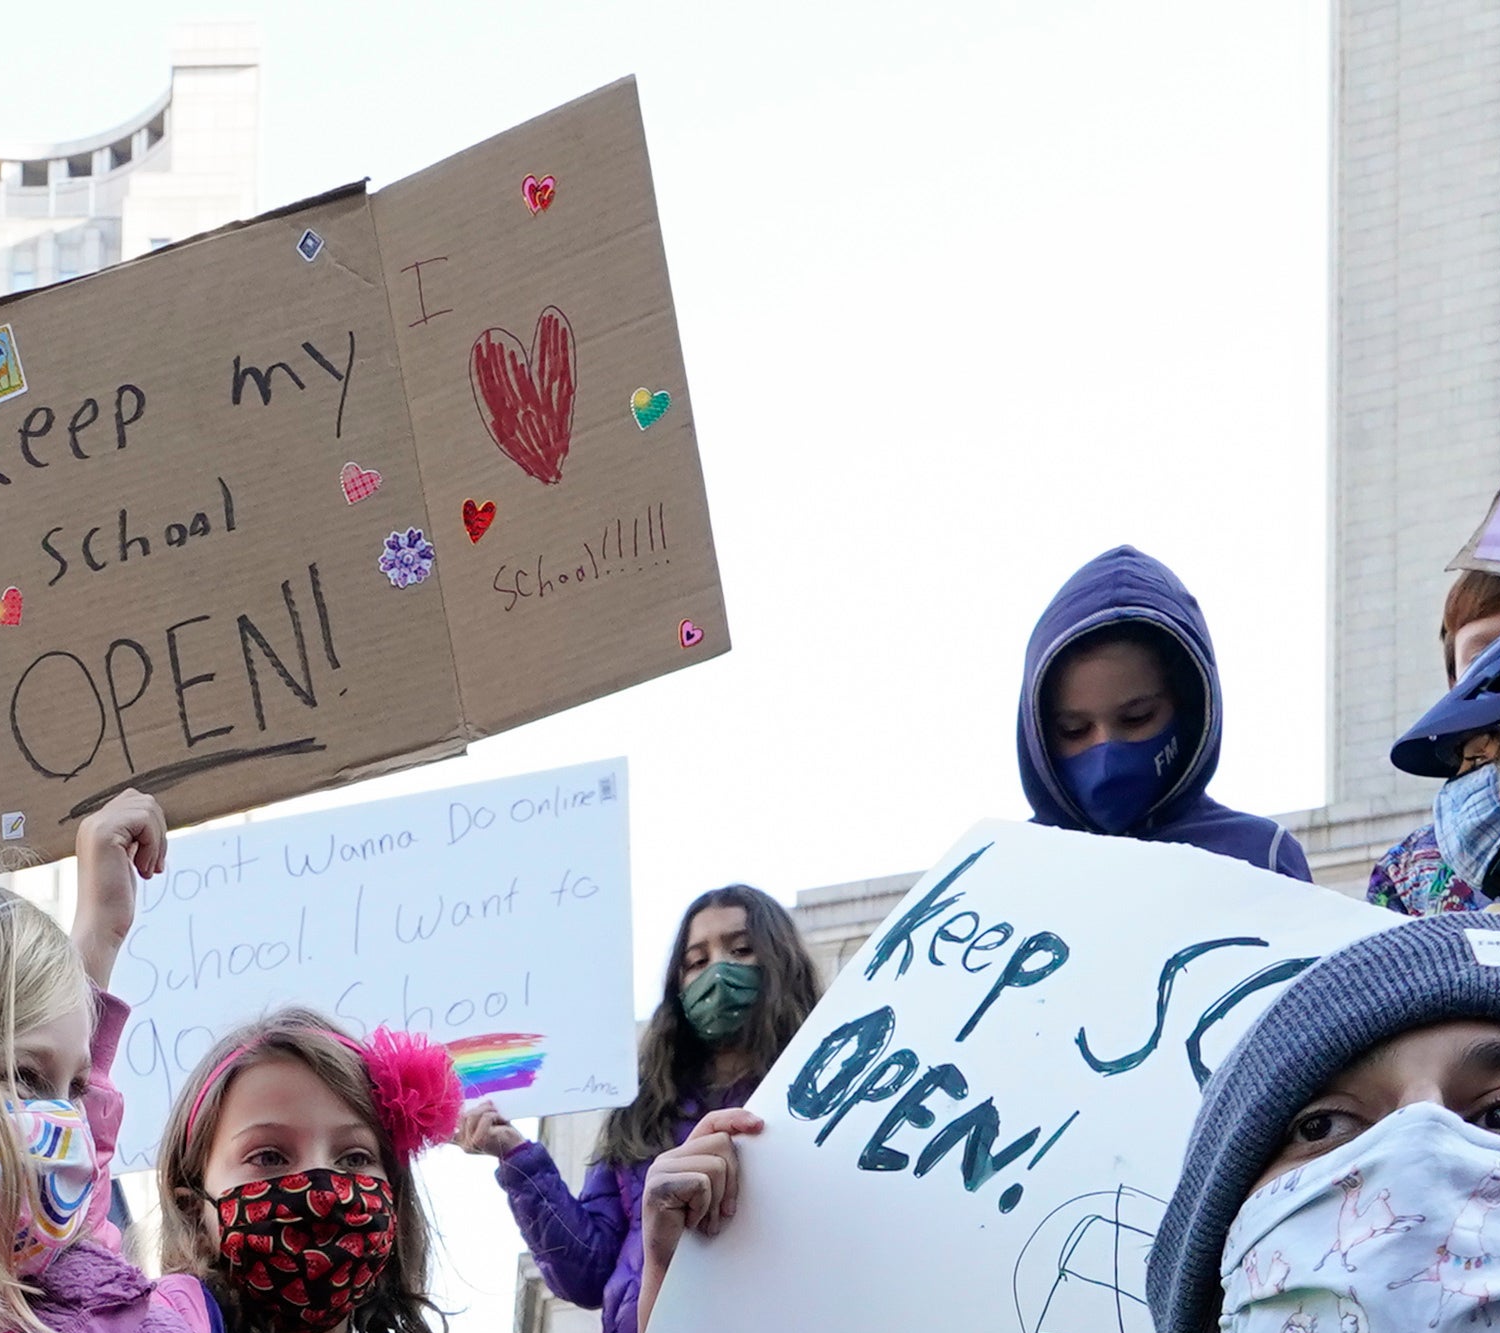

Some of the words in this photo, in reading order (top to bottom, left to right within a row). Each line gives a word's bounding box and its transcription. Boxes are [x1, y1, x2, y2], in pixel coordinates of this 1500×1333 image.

[400, 254, 456, 329] I
[230, 331, 356, 438] my
[8, 562, 350, 782] OPEN!
[283, 829, 420, 879] Wanna
[446, 800, 498, 848] Do
[550, 867, 601, 908] to
[786, 1005, 1081, 1214] OPEN!
